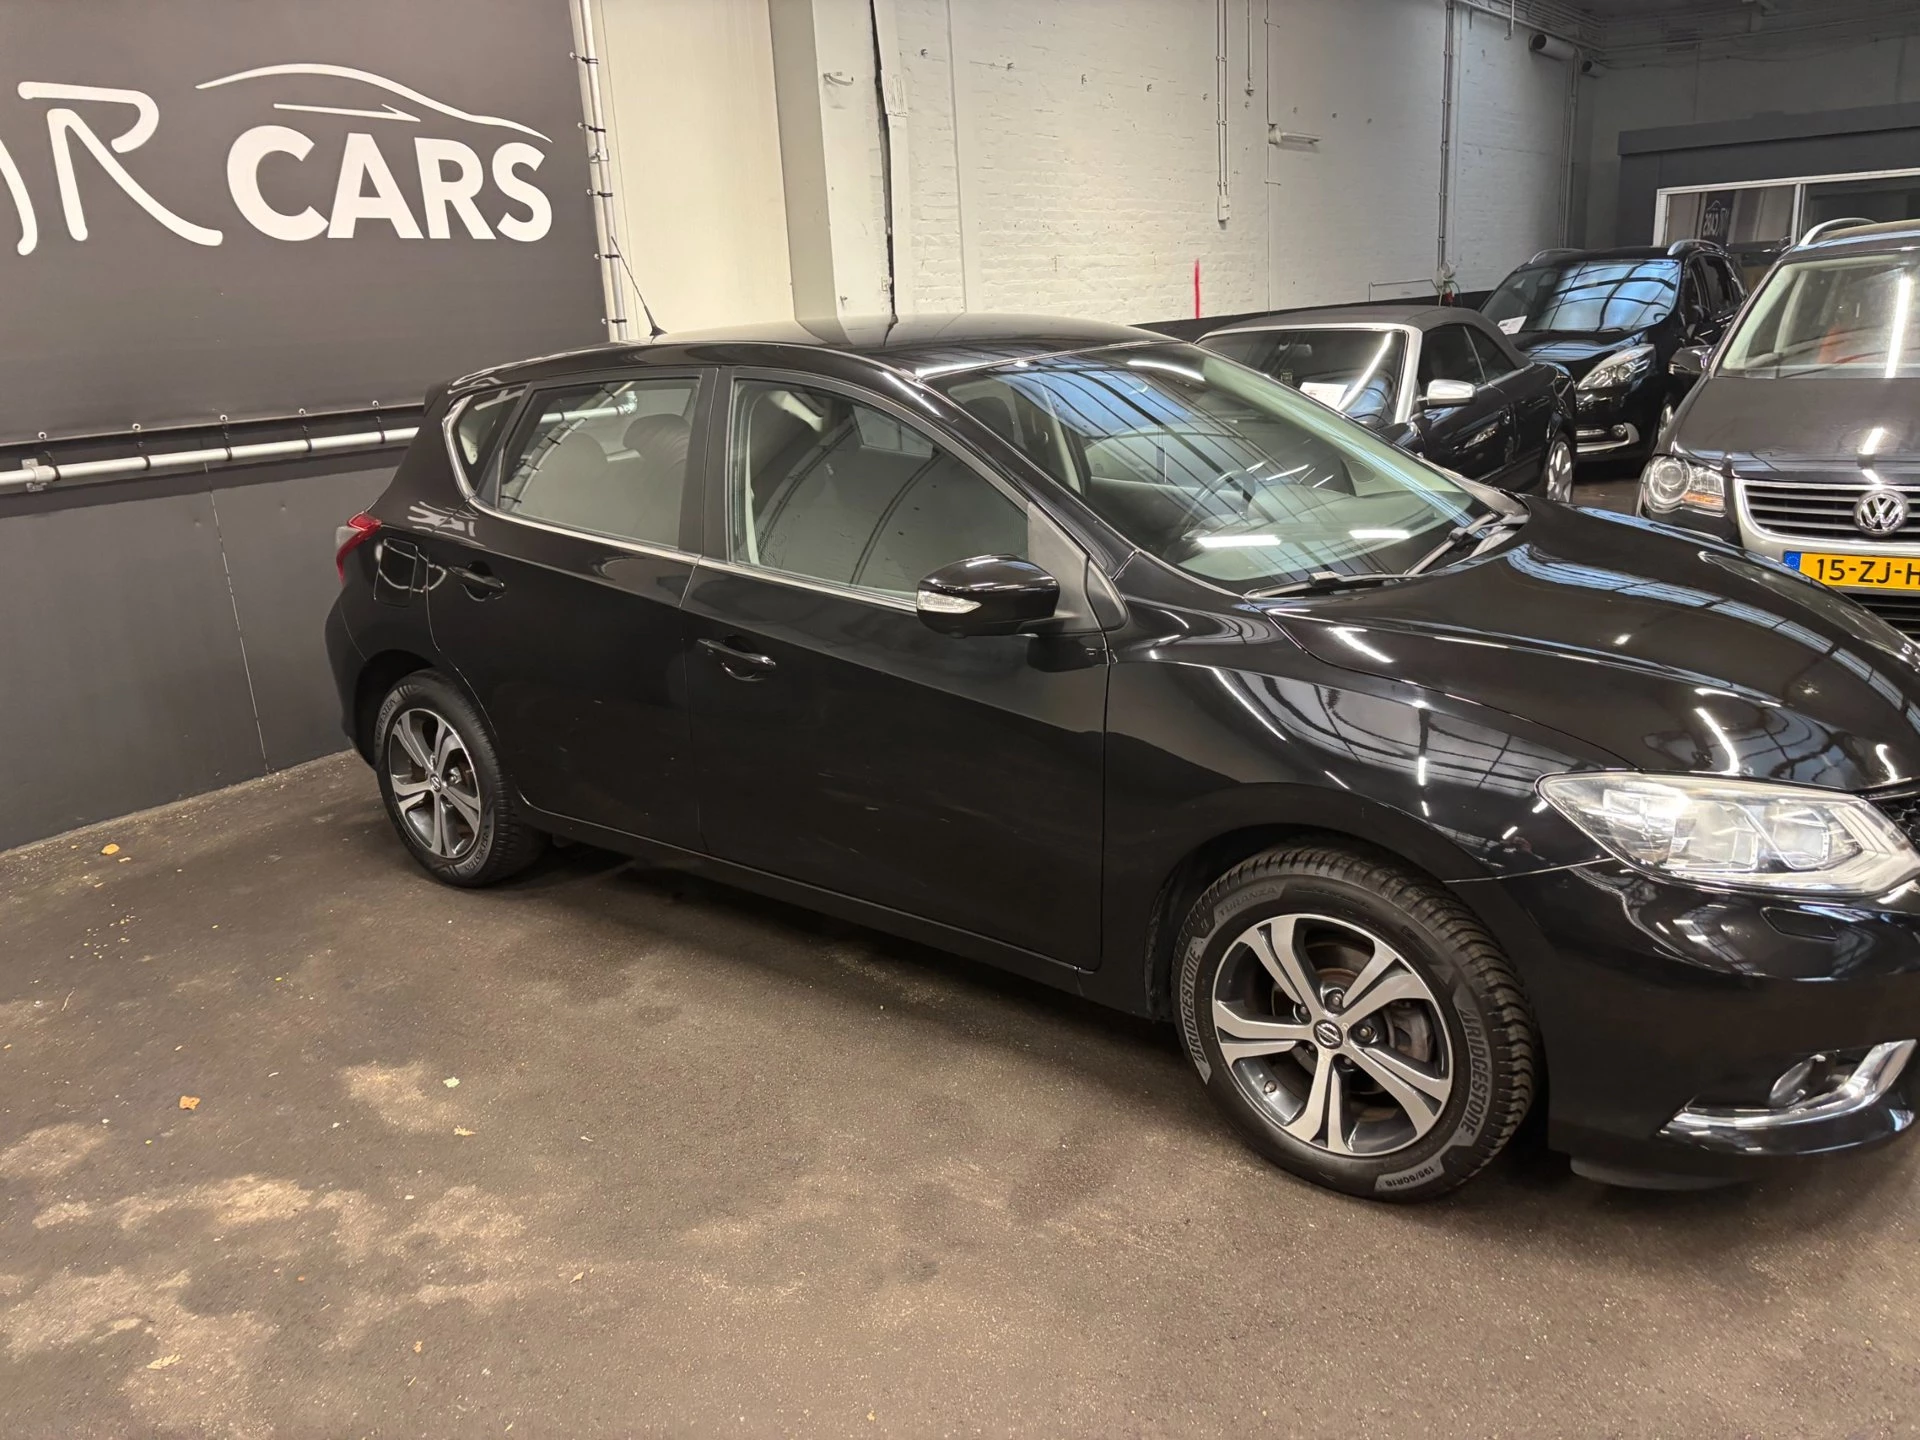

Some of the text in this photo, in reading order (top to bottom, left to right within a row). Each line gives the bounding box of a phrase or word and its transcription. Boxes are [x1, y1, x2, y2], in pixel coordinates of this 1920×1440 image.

[227, 125, 552, 242] CARS
[1180, 947, 1207, 1064] BRIDGESTONE
[1457, 1008, 1489, 1137] BRIDGESTONE
